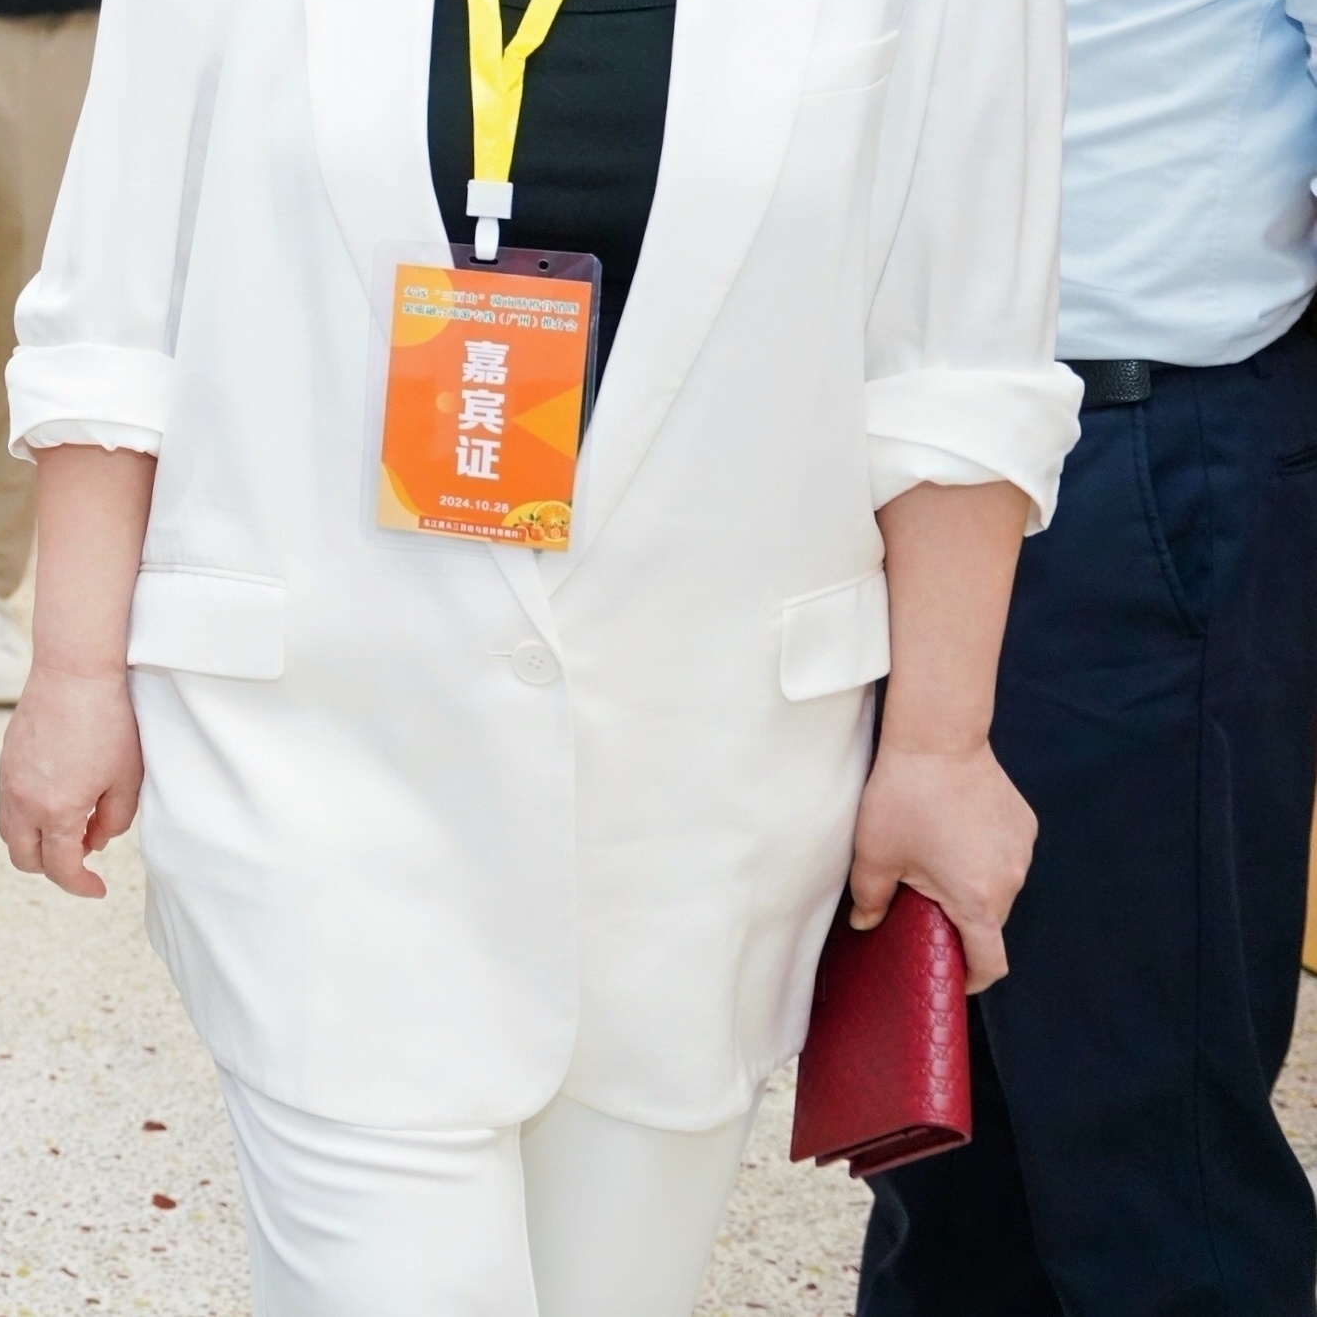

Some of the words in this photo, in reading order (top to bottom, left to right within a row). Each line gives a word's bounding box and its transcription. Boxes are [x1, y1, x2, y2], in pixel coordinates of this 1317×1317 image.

[456, 339, 510, 481] 嘉宾证
[438, 495, 510, 514] 2024.10.28
